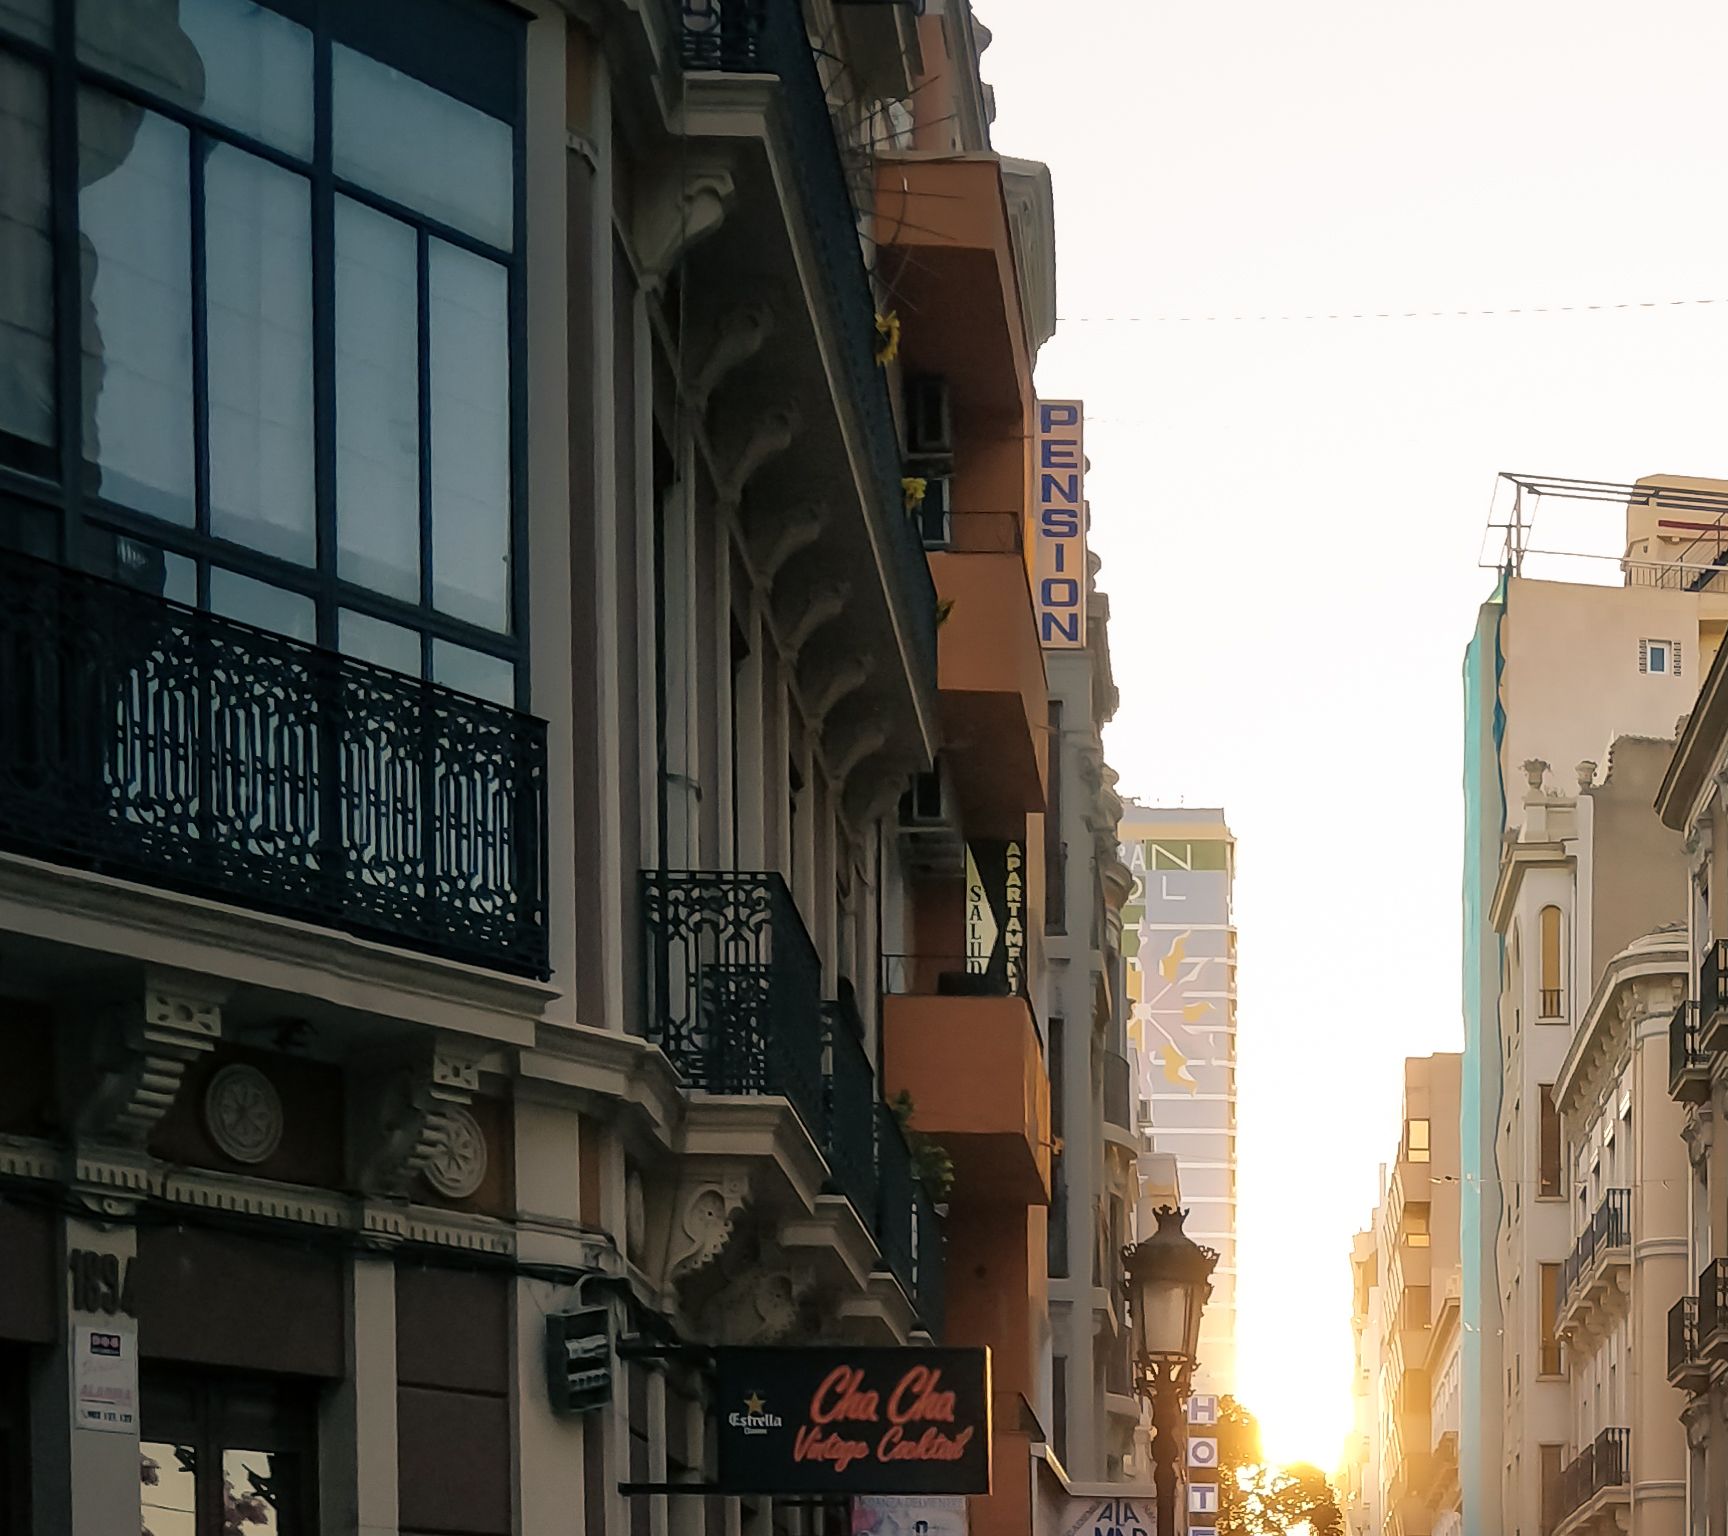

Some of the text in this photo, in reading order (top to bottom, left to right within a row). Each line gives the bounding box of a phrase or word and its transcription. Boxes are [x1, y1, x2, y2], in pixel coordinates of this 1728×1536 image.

[1040, 404, 1079, 642] PENSION
[728, 1411, 783, 1428] Estrella
[809, 1364, 957, 1425] Cha Cha
